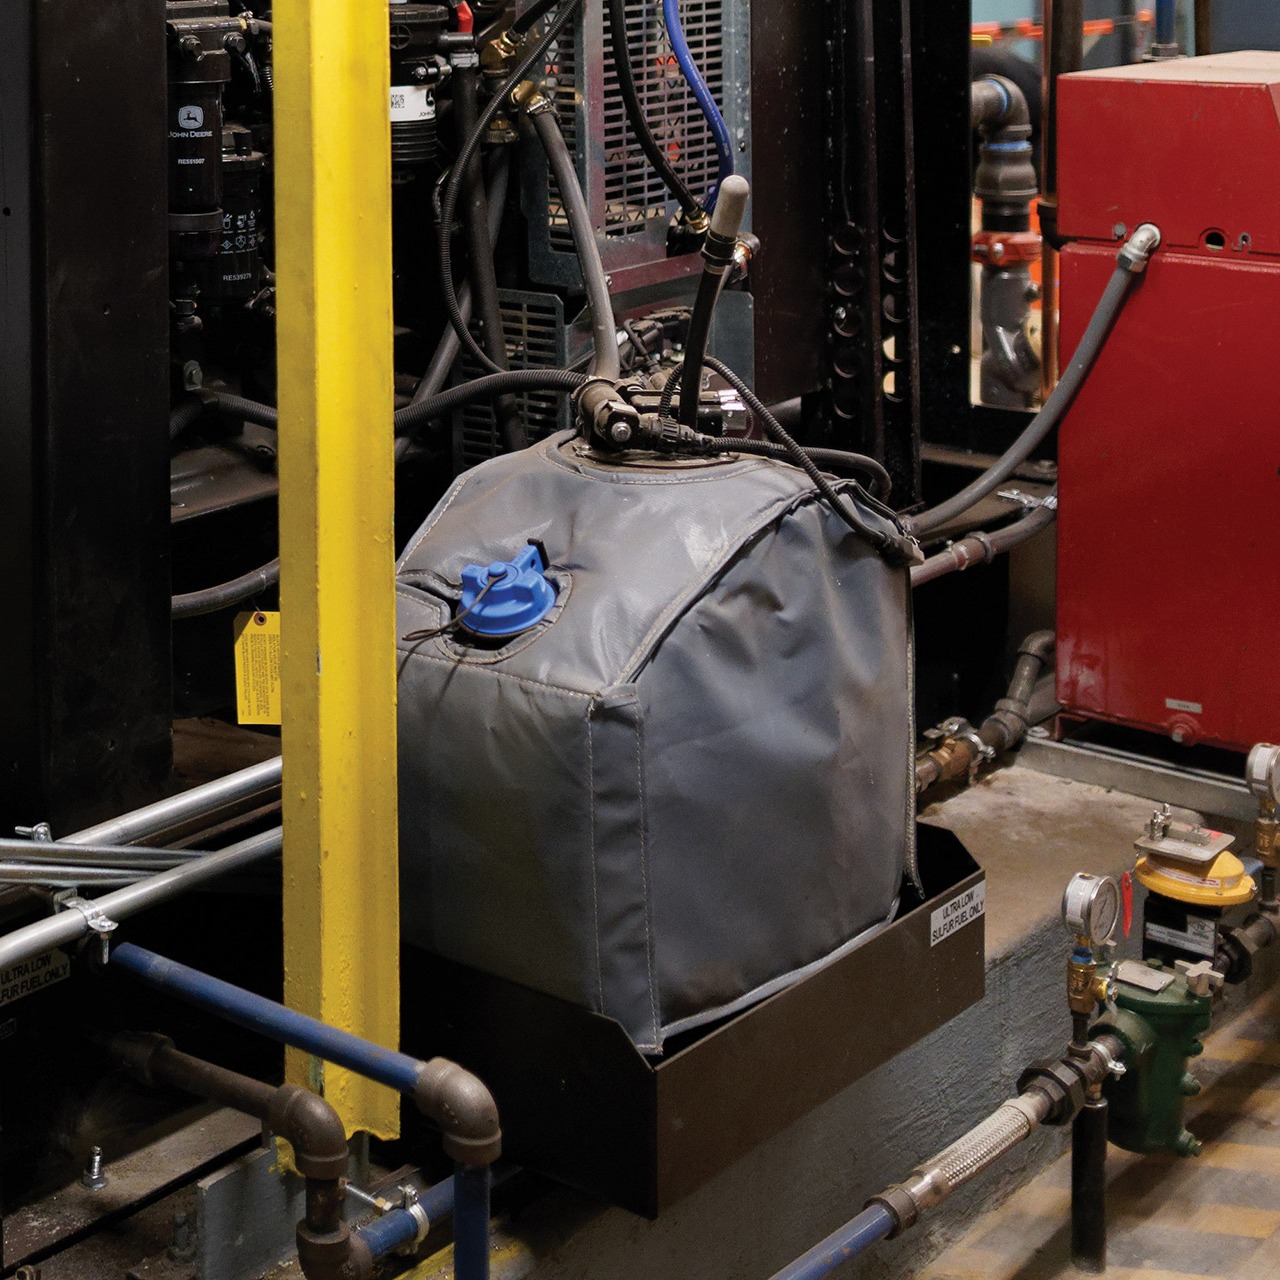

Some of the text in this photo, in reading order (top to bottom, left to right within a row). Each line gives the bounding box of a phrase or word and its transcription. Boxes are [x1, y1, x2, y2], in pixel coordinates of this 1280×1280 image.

[168, 130, 213, 138] JOHN DEERE
[942, 890, 975, 920] ULTRA LOW
[932, 900, 984, 942] SULFUR FUEL ONLY
[0, 953, 52, 985] ULTRA LOW
[20, 974, 42, 994] FUEL
[43, 963, 69, 984] ONLY
